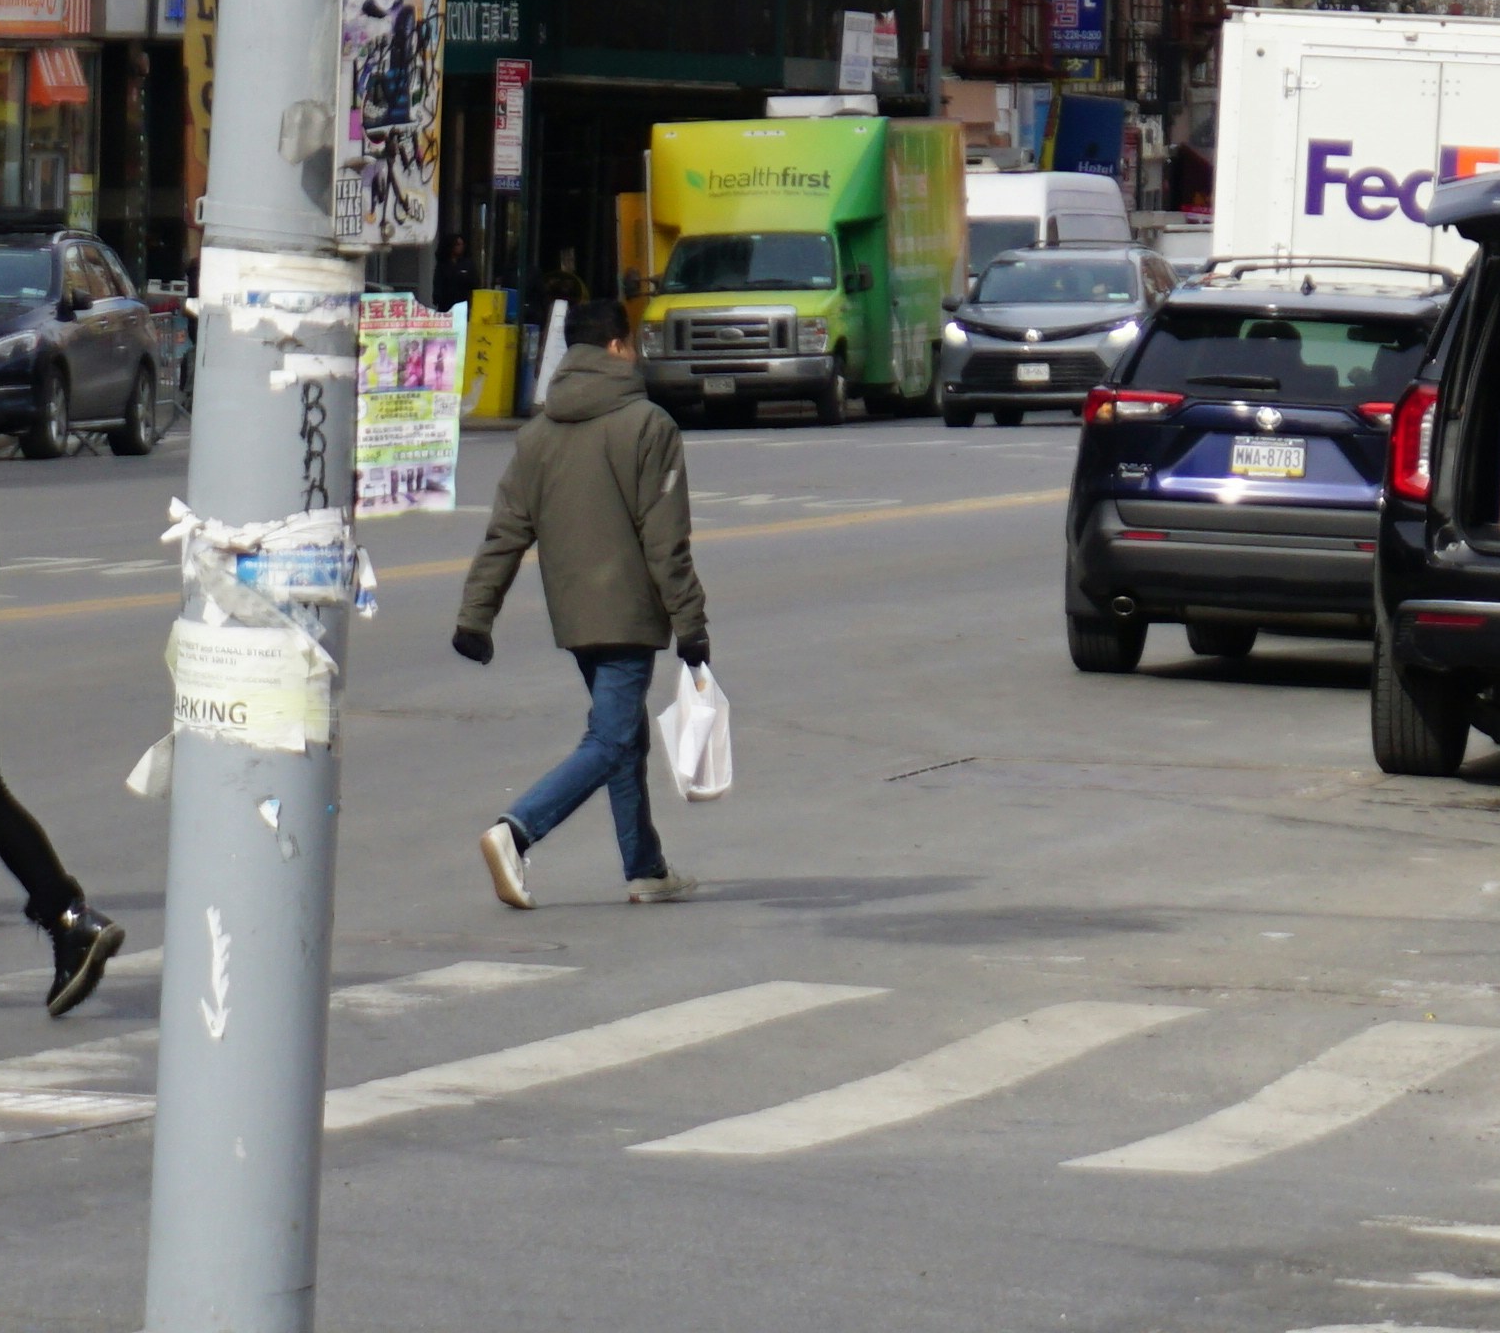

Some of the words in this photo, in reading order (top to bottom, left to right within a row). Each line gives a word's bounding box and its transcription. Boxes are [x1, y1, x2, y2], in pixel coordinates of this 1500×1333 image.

[708, 166, 831, 190] healthfirst
[1235, 448, 1301, 468] MWA-8783
[214, 645, 246, 656] CANAL
[246, 648, 283, 659] STREET
